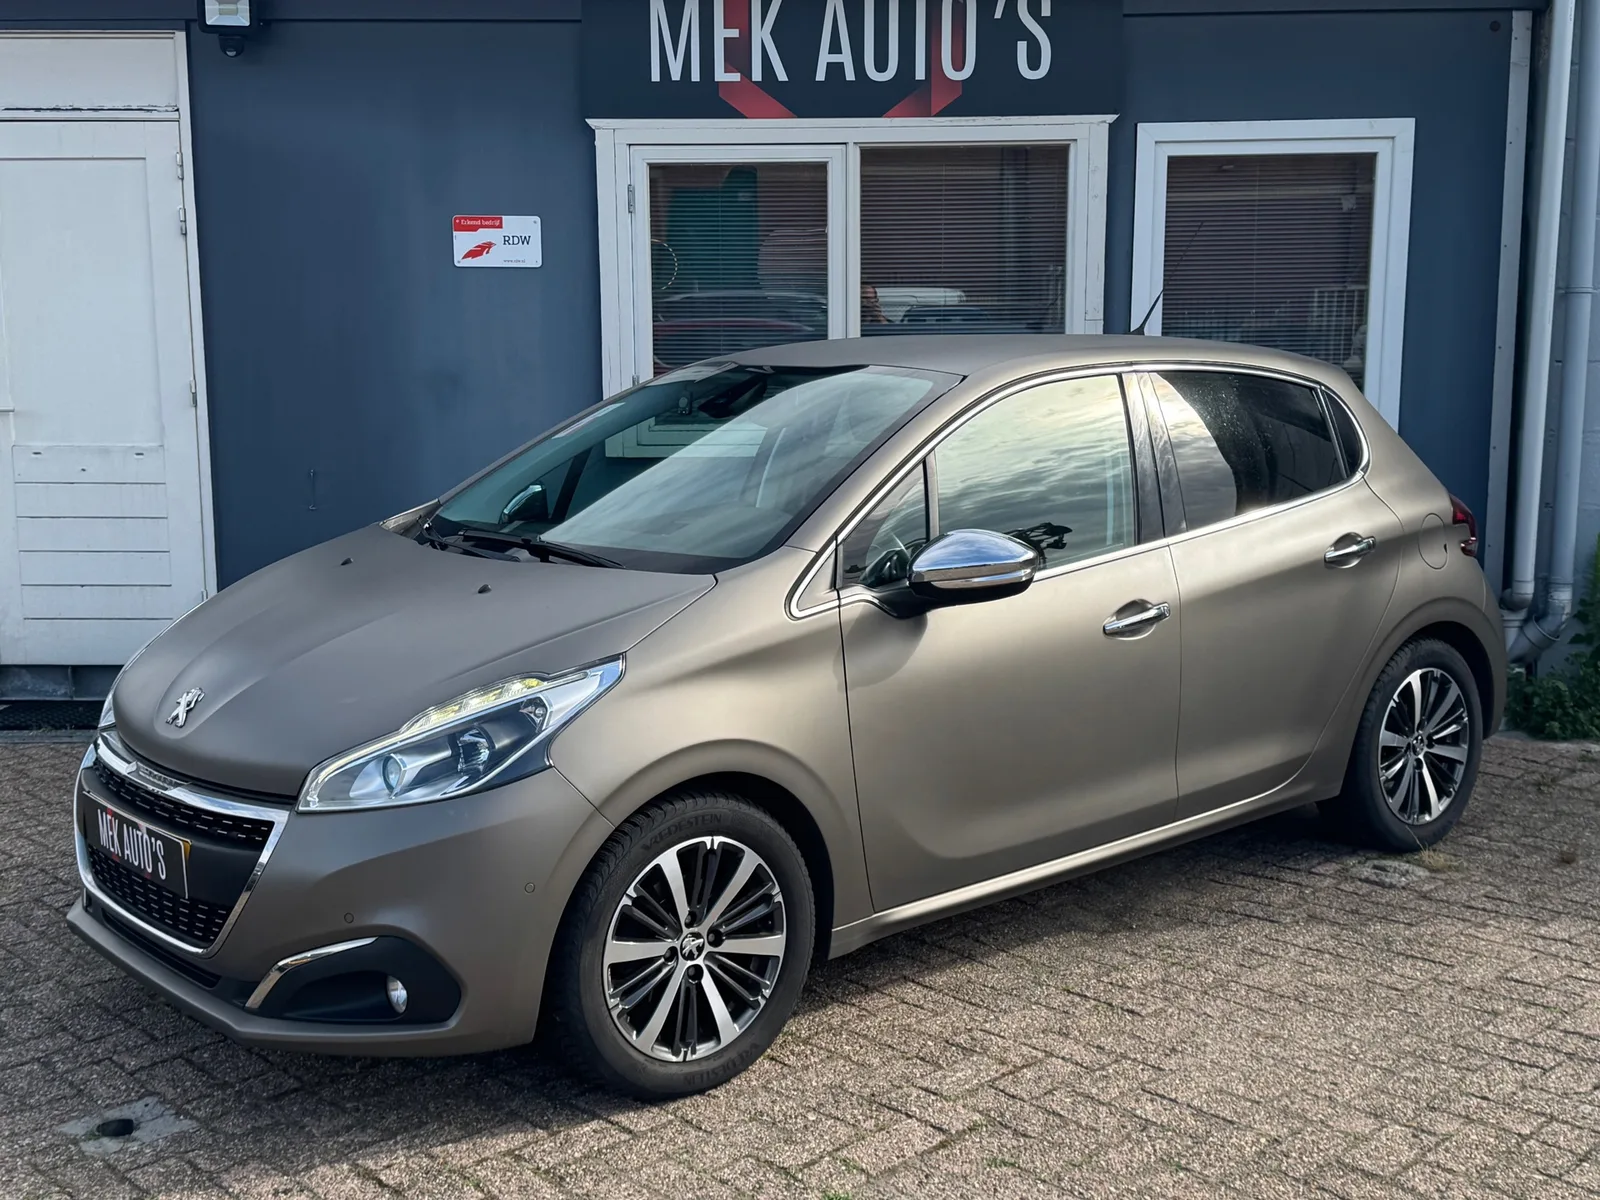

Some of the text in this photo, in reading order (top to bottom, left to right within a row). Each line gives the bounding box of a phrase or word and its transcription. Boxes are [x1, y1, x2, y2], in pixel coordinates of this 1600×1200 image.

[649, 0, 1052, 82] MEK AUTO'S
[503, 235, 531, 246] RDW
[97, 808, 167, 881] MEK AUTO'S
